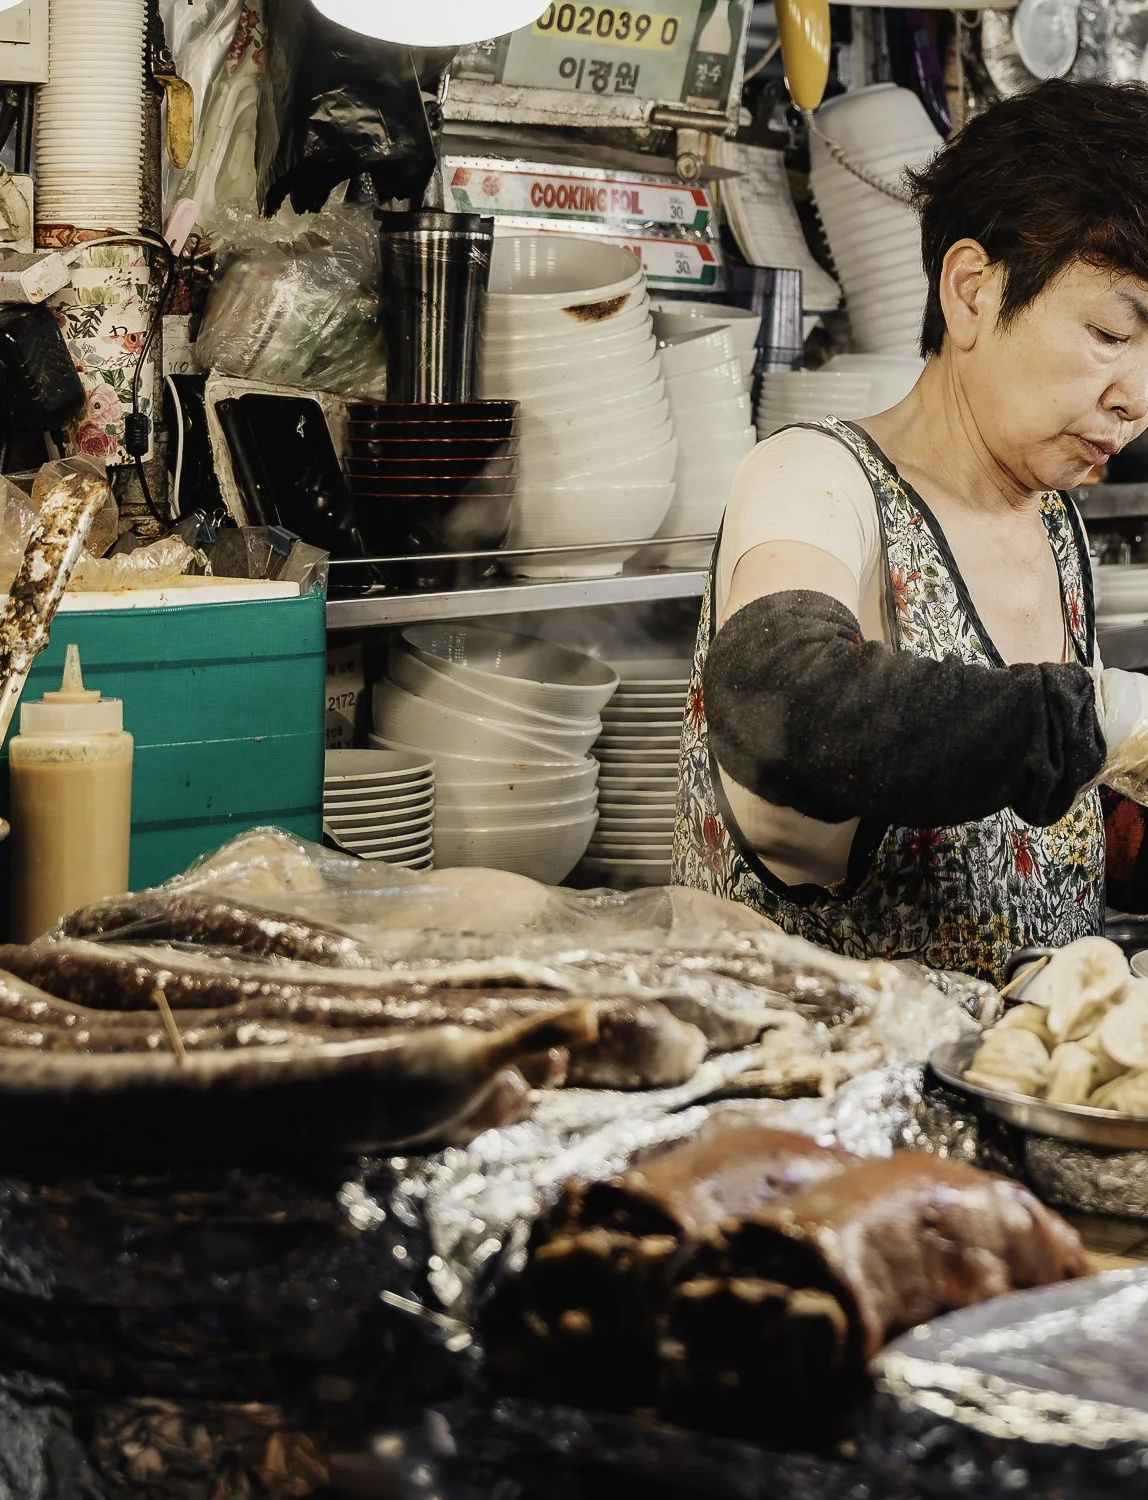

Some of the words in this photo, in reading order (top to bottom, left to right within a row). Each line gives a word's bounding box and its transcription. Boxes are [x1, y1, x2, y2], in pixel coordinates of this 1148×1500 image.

[558, 56, 640, 94] 이경원
[530, 182, 607, 212] COOKING
[328, 691, 356, 713] 2172
